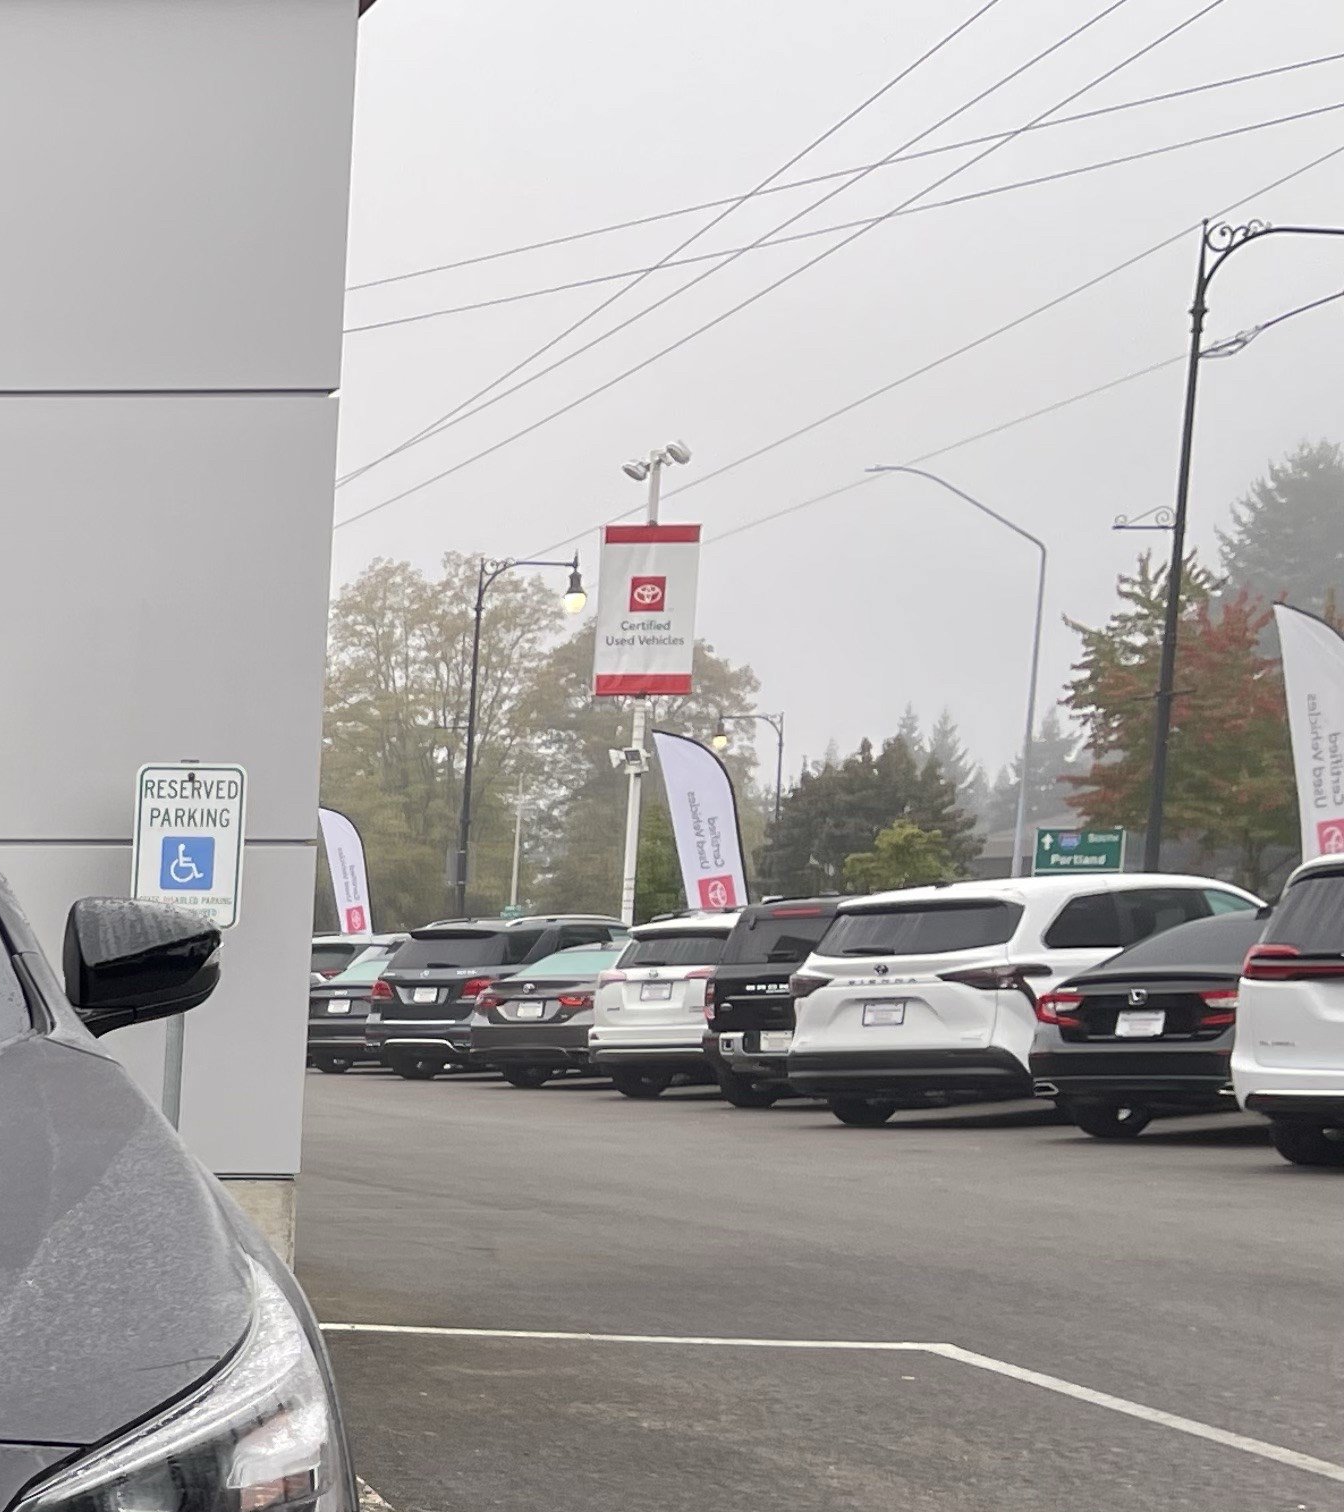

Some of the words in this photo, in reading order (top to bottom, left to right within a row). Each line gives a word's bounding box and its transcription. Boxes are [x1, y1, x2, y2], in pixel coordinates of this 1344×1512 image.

[620, 620, 672, 631] Certified
[605, 635, 635, 646] Used
[638, 635, 685, 646] Vehicles
[144, 779, 239, 800] RESERVED
[150, 808, 230, 828] PARKING
